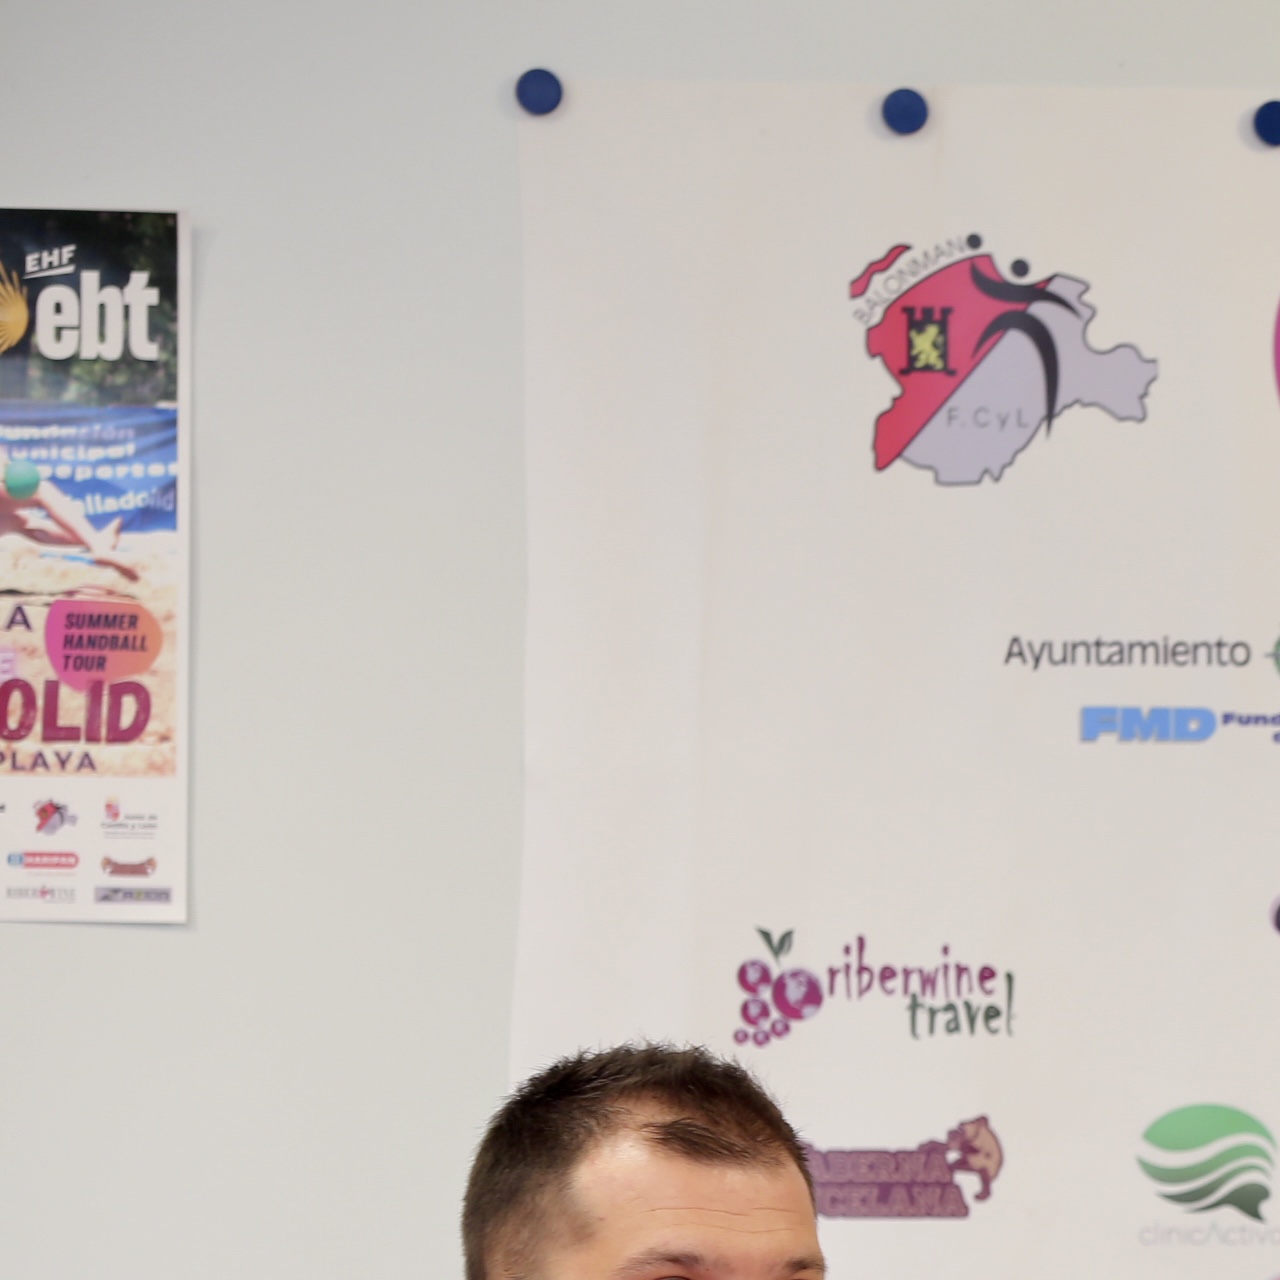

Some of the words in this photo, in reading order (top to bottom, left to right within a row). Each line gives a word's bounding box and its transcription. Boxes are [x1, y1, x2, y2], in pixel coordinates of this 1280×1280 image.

[25, 245, 76, 273] EHF
[36, 270, 160, 361] ebt
[65, 613, 138, 630] SUMMER
[63, 635, 147, 652] HANDBALL
[1003, 635, 1252, 671] Ayuntamiento
[63, 655, 106, 671] TOUR
[1080, 705, 1218, 743] FMD
[827, 934, 998, 1000] riberwine
[907, 971, 1015, 1039] travel
